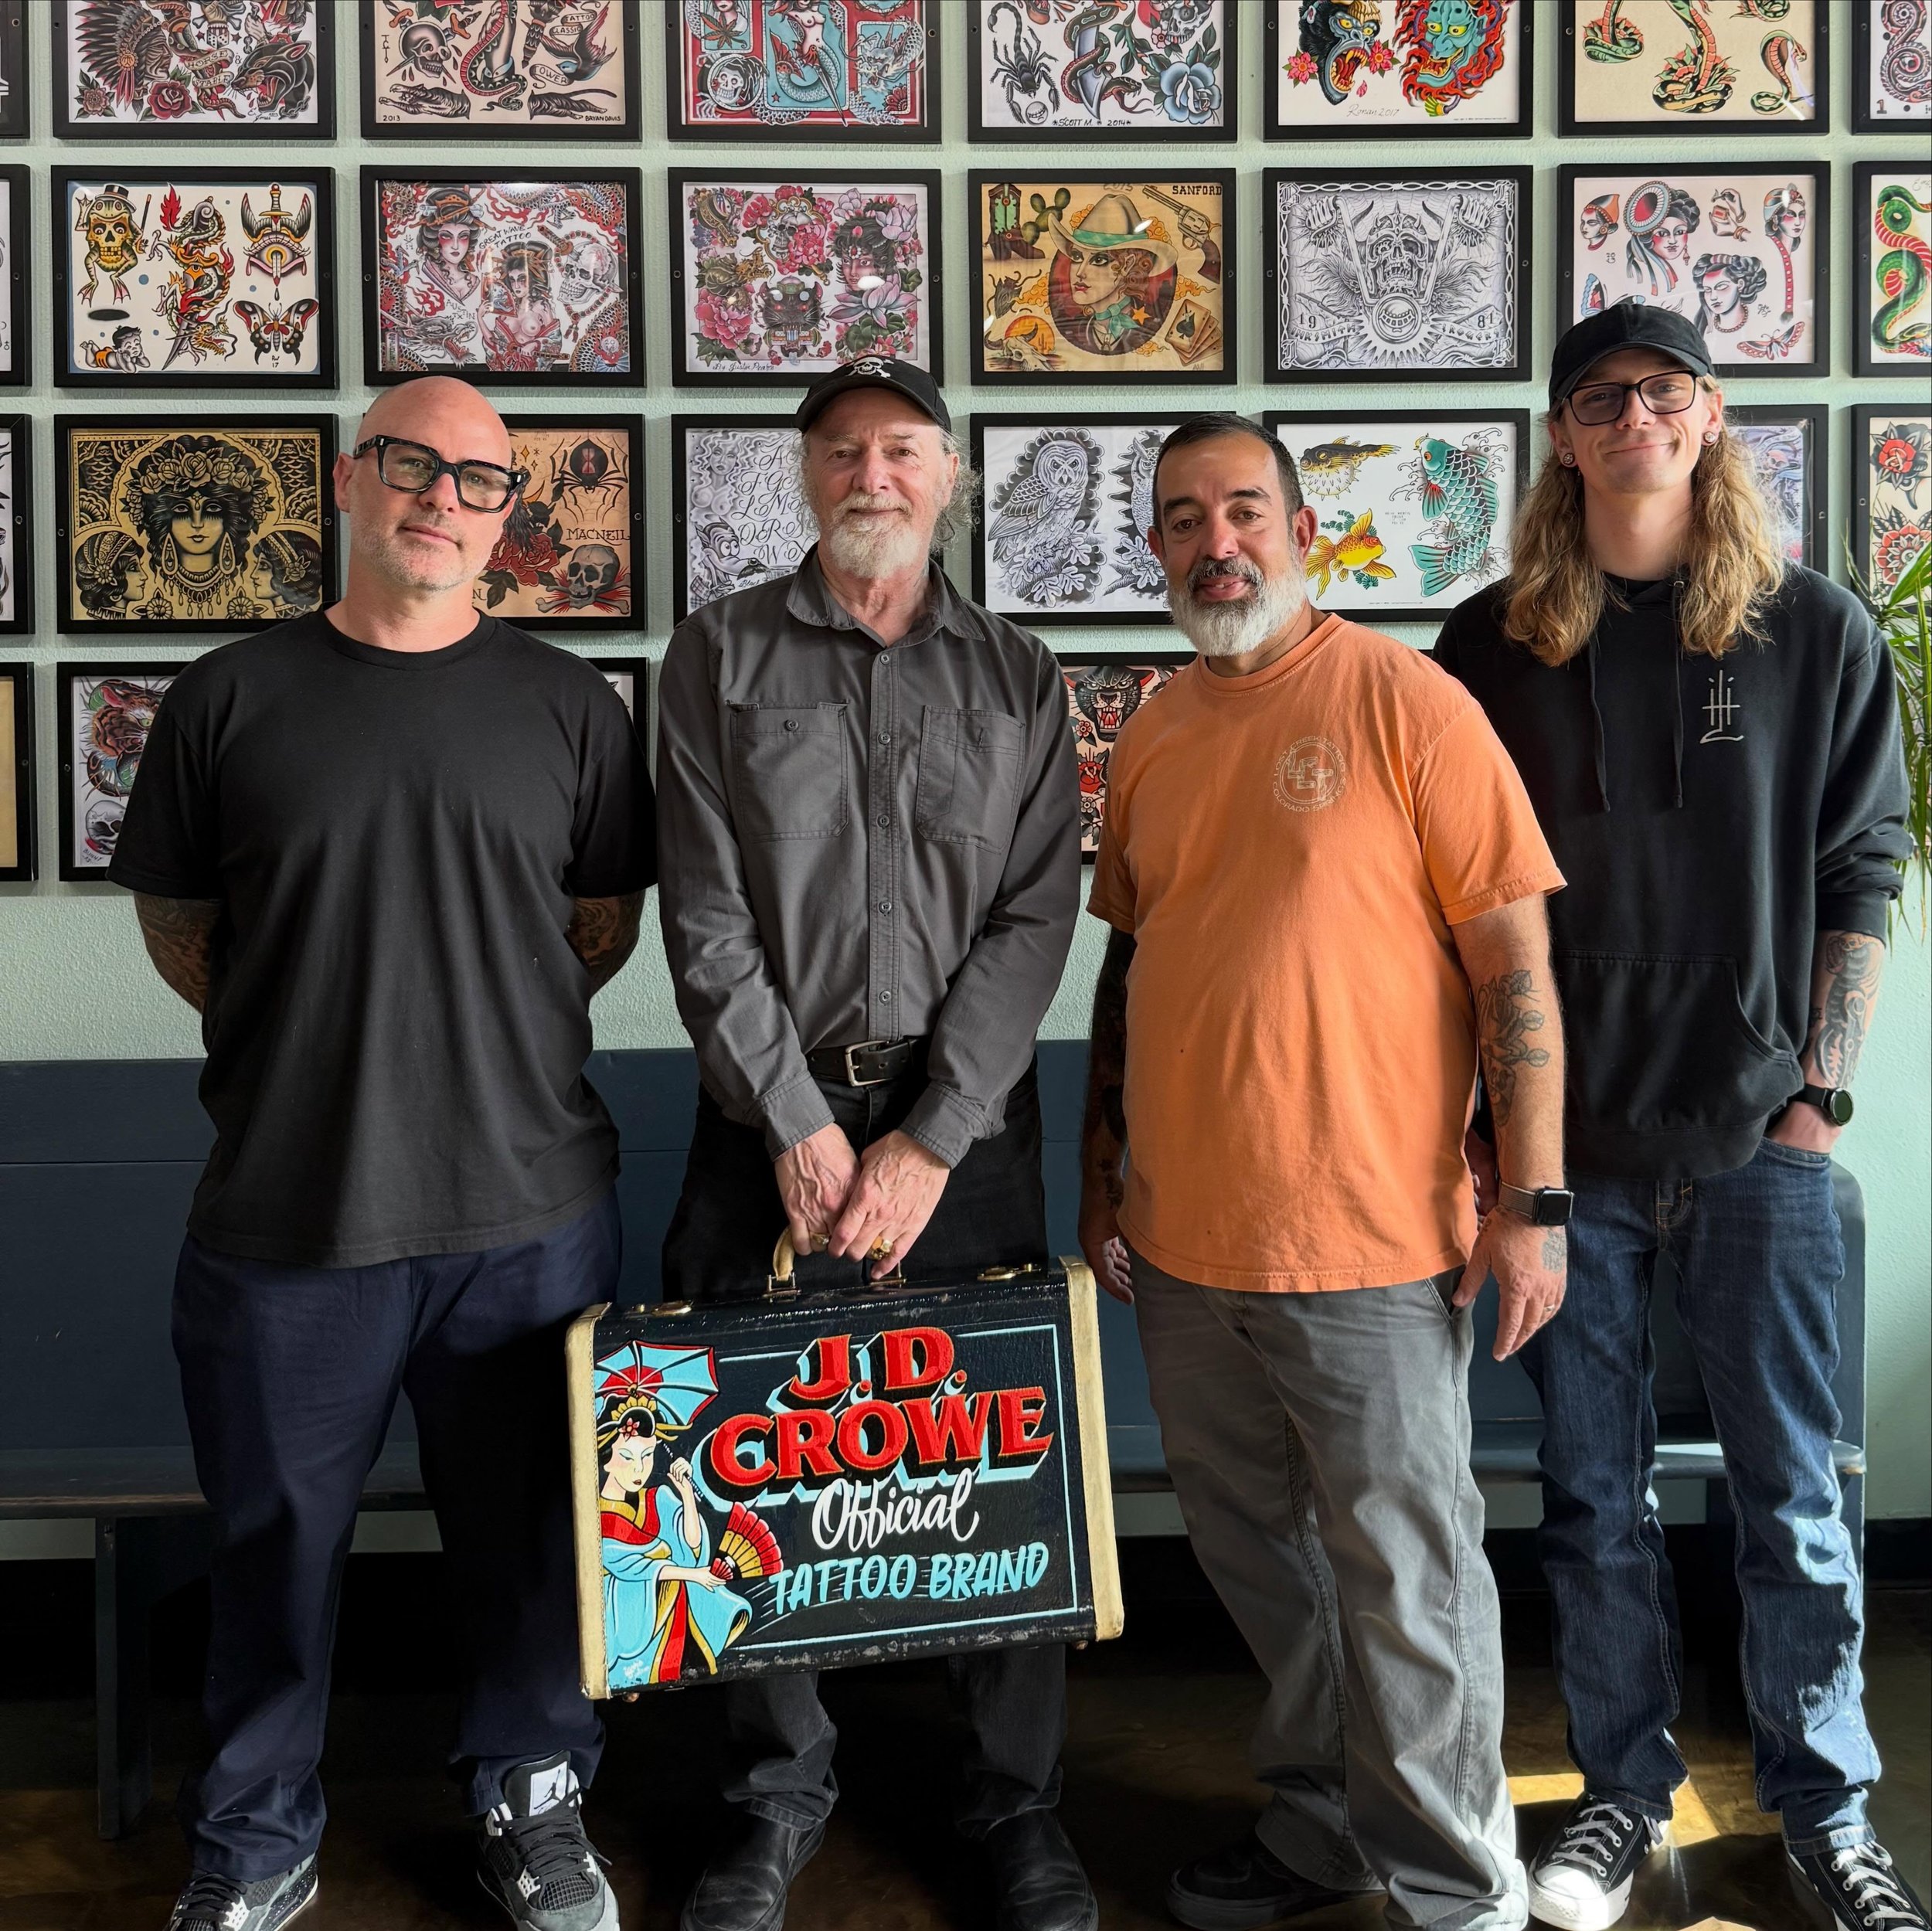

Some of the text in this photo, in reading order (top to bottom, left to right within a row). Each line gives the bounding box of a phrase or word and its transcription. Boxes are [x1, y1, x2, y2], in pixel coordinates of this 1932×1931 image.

[565, 13, 596, 22] TATTOO
[186, 49, 230, 69] HORSE
[195, 75, 231, 87] STABLE
[533, 66, 568, 84] TOWER
[1876, 99, 1887, 114] 1
[1059, 117, 1082, 127] SCOTT
[1172, 185, 1222, 195] SANFORD
[478, 225, 526, 250] GREAT WAVE
[495, 233, 532, 248] TATTOO
[1300, 312, 1495, 328] 19 81
[566, 527, 630, 546] MACNEIL
[1274, 750, 1288, 777] LOST
[1322, 737, 1346, 773] TATTOO
[1272, 781, 1311, 813] COLORADO
[709, 1386, 1055, 1487] CROWE
[811, 1467, 980, 1552] Official
[769, 1542, 1050, 1616] TATTOO BRAND
